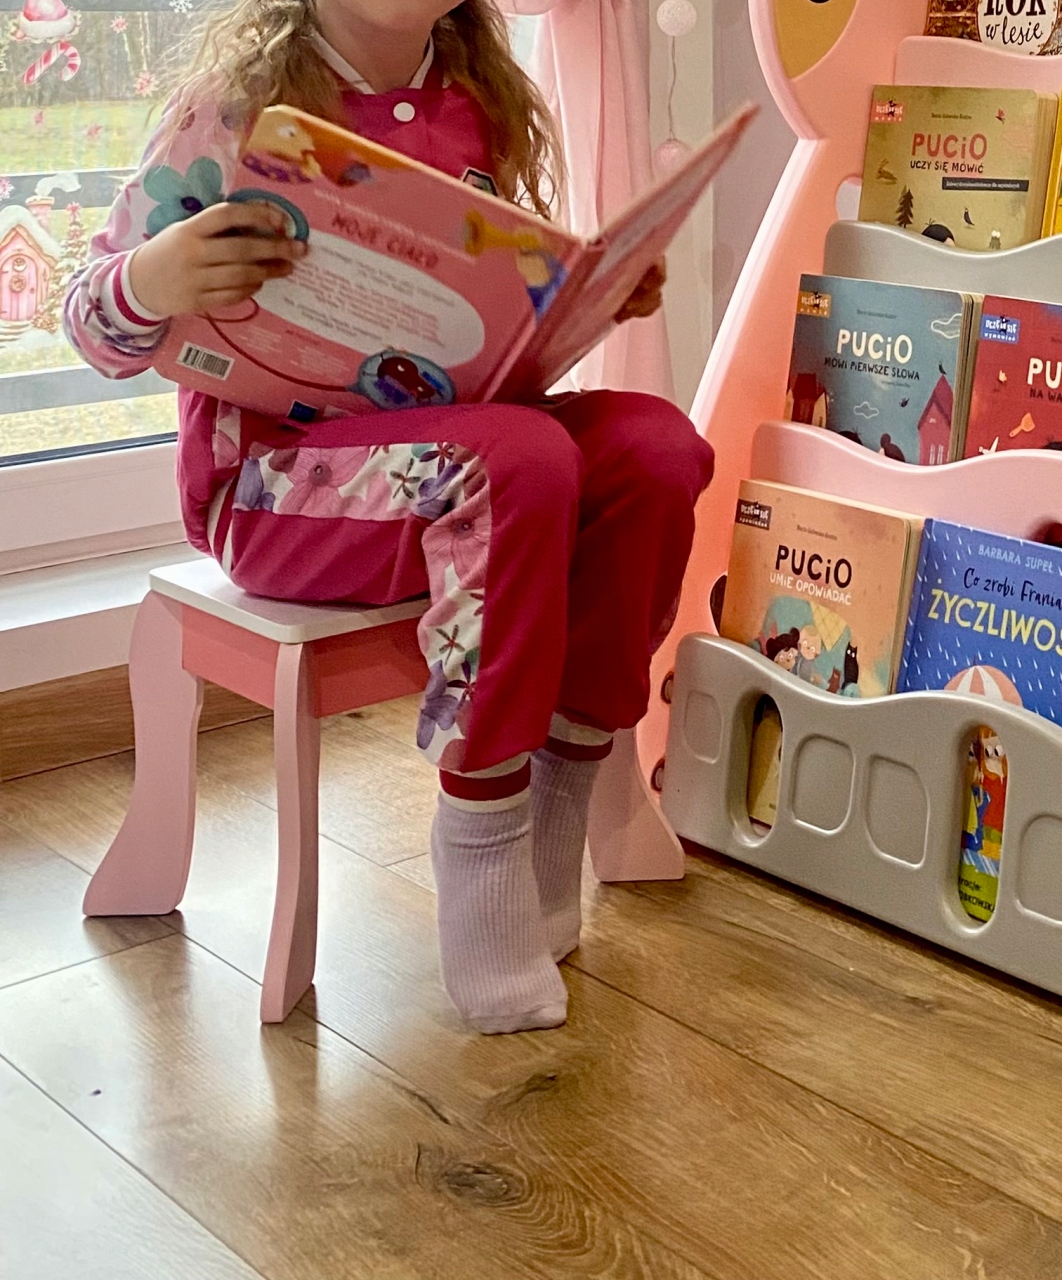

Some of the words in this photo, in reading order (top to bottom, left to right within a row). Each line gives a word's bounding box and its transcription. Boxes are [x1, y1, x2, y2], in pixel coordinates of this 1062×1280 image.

[986, 23, 1000, 40] w
[1001, 16, 1043, 45] lesie
[910, 160, 931, 170] UCZY
[891, 367, 920, 380] SŁOWA
[1029, 388, 1043, 399] NA
[978, 544, 1021, 565] BARBARA
[1025, 556, 1054, 573] SUPEŁ
[963, 568, 980, 589] Co
[984, 577, 1015, 597] zrobi
